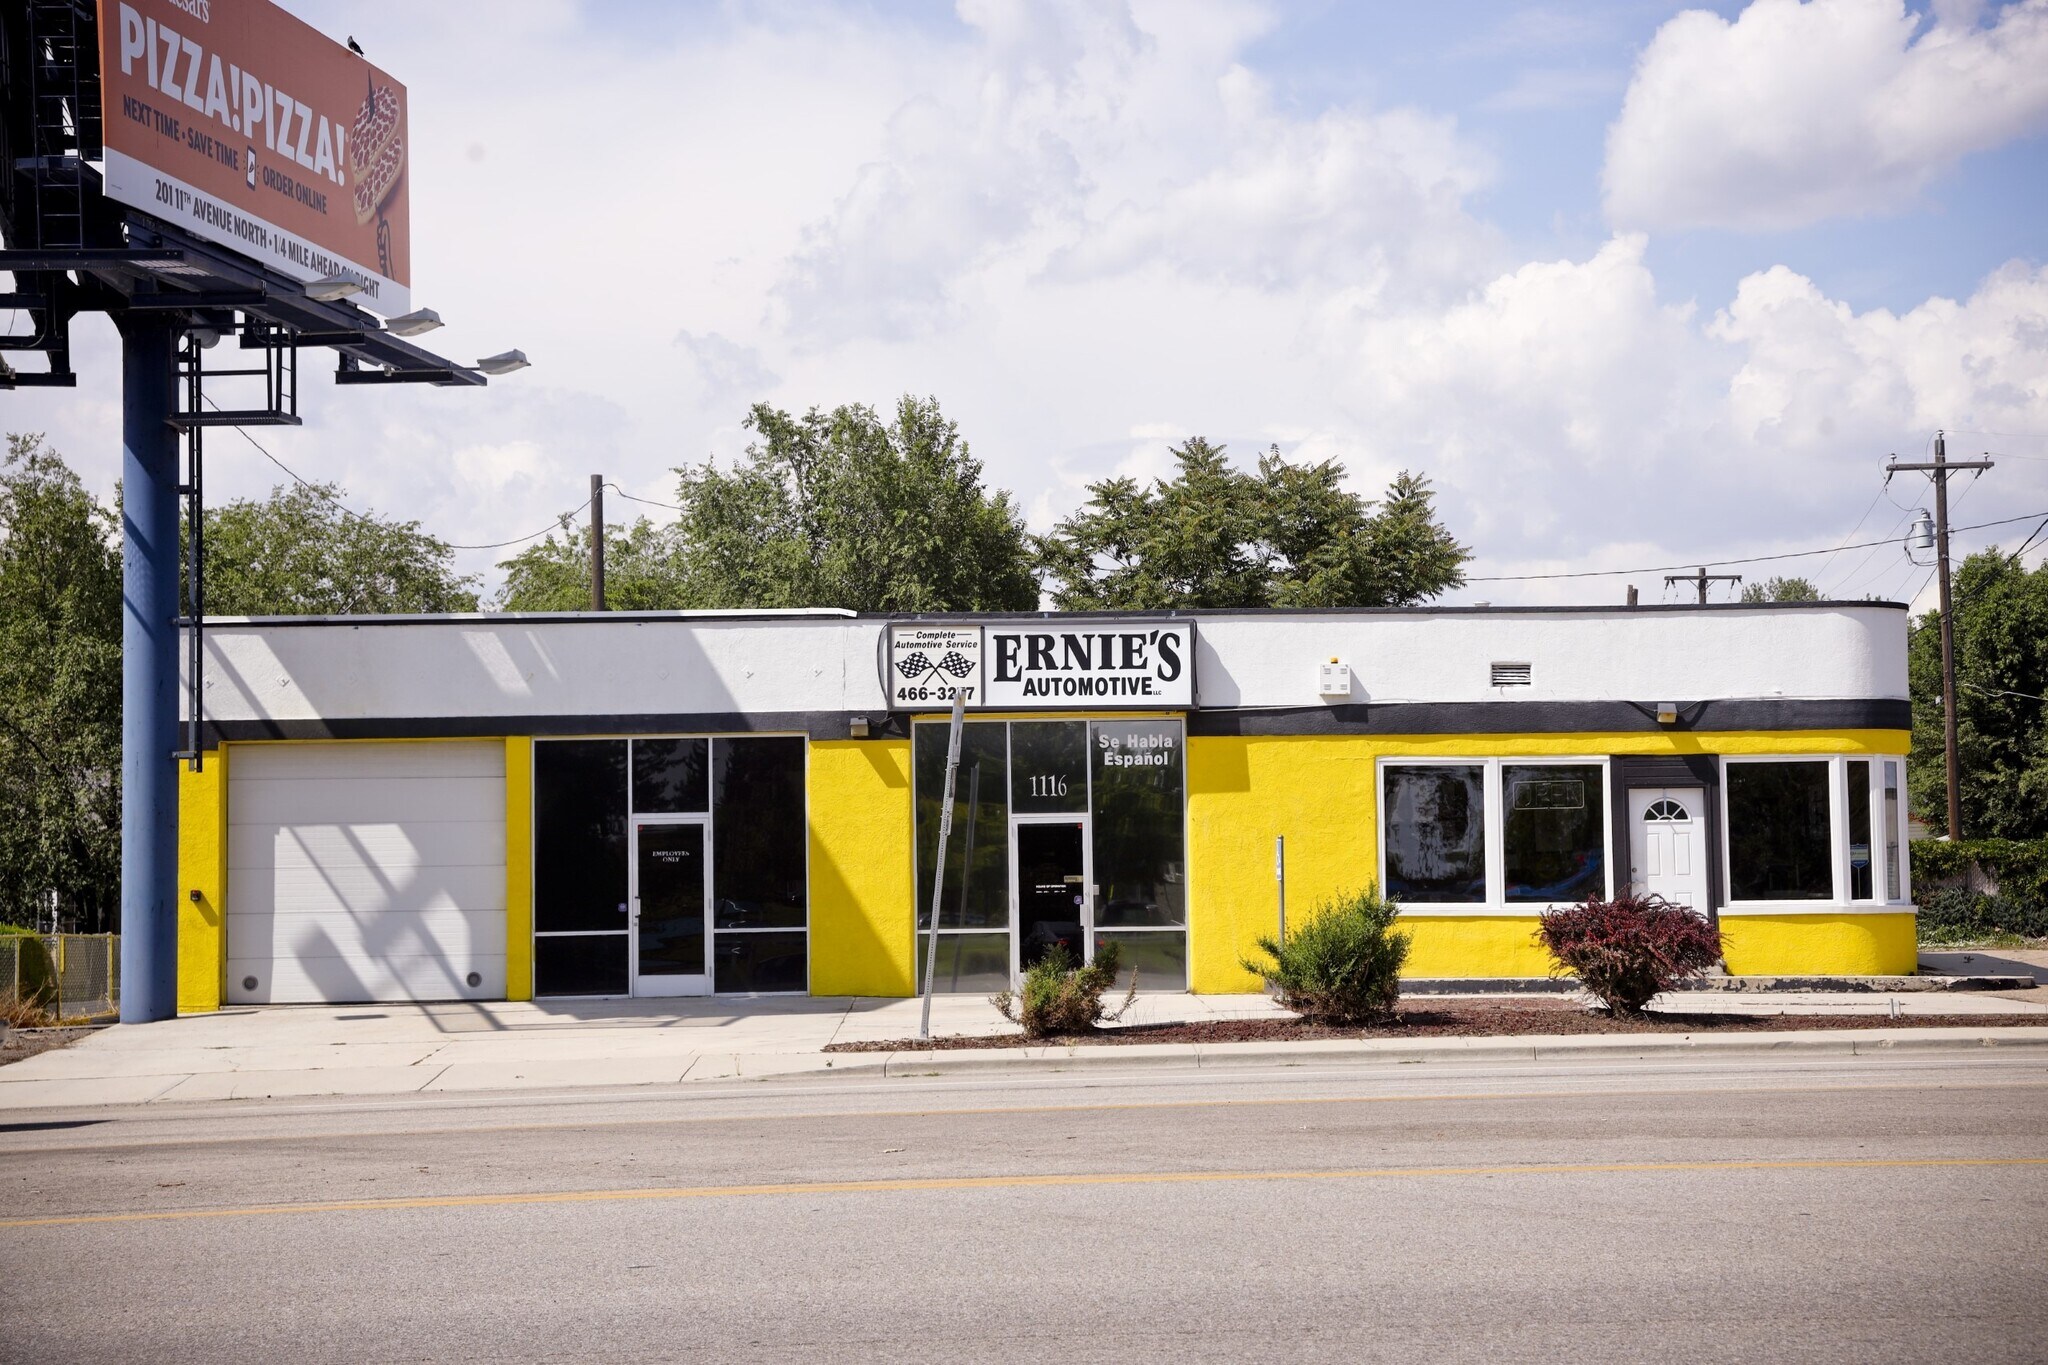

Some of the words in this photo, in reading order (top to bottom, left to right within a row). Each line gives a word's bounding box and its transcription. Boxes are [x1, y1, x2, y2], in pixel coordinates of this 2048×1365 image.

[123, 94, 152, 128] NEXT
[153, 109, 180, 142] TIME
[187, 126, 213, 158] SAVE
[214, 140, 239, 171] TIME
[262, 165, 294, 199] ORDER
[295, 182, 327, 215] ONLINE
[155, 179, 173, 206] 201
[193, 197, 232, 233] AVENUE
[233, 215, 267, 249] NORTH
[274, 234, 287, 258] 1/4
[288, 240, 309, 268] MILE
[310, 251, 340, 277] AHEAD
[355, 271, 380, 300] IGHT
[894, 641, 943, 649] Automotive
[945, 640, 978, 649] Service
[916, 631, 956, 640] Complete
[993, 630, 1181, 682] ERNIE'S
[1022, 677, 1152, 696] AUTOMOTIVE
[1098, 734, 1120, 748] Se
[1127, 734, 1173, 748] Habla
[1104, 751, 1168, 768] Español
[1029, 774, 1067, 797] 1116
